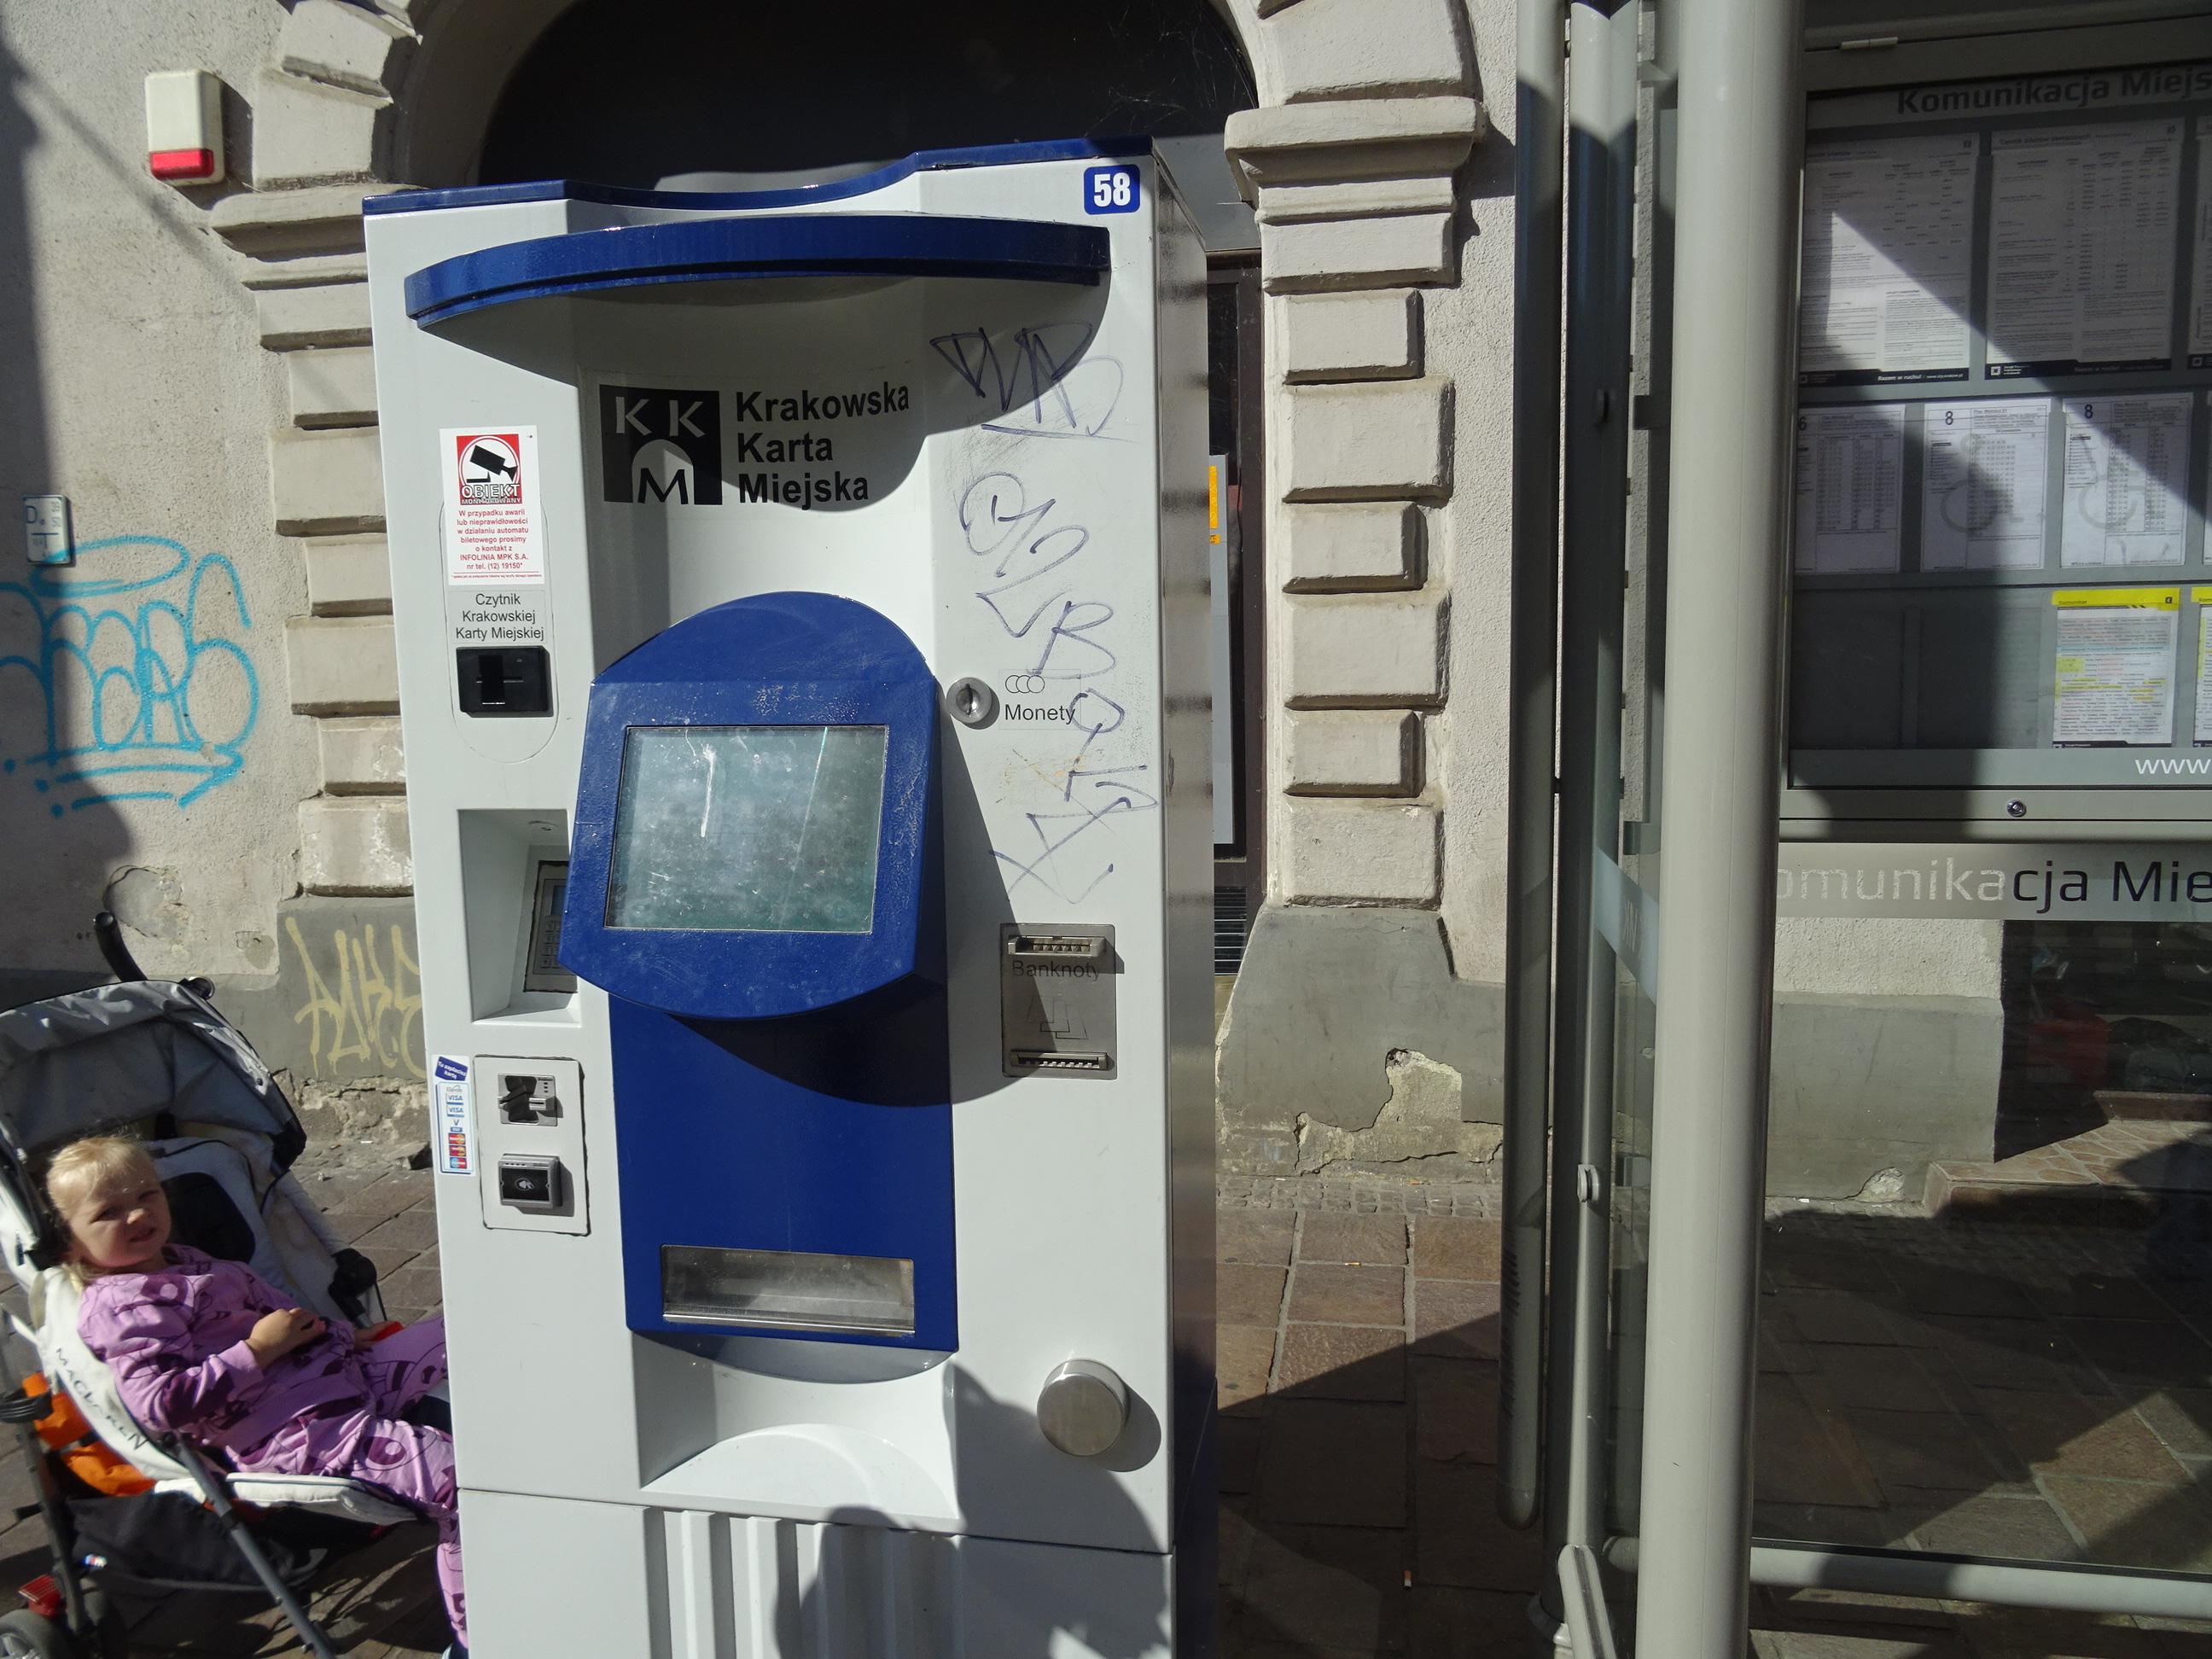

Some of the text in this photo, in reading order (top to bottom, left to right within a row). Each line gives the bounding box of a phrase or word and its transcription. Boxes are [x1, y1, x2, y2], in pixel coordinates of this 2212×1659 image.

[1897, 75, 2110, 114] Komunikacja
[1094, 172, 1130, 207] 58
[736, 381, 910, 422] Krakowska
[1946, 410, 1953, 426] 8
[2085, 404, 2093, 419] 8
[737, 432, 833, 463] Karta
[462, 483, 520, 498] OBIEKT
[738, 471, 869, 511] Miejska
[468, 509, 503, 518] przypadku
[488, 562, 499, 571] (12)
[475, 592, 521, 608] Czytnik
[462, 609, 537, 625] Krakowskiej
[456, 626, 544, 642] Karty Miejskiej
[1004, 703, 1076, 725] Monety
[1012, 960, 1099, 981] Banknoty
